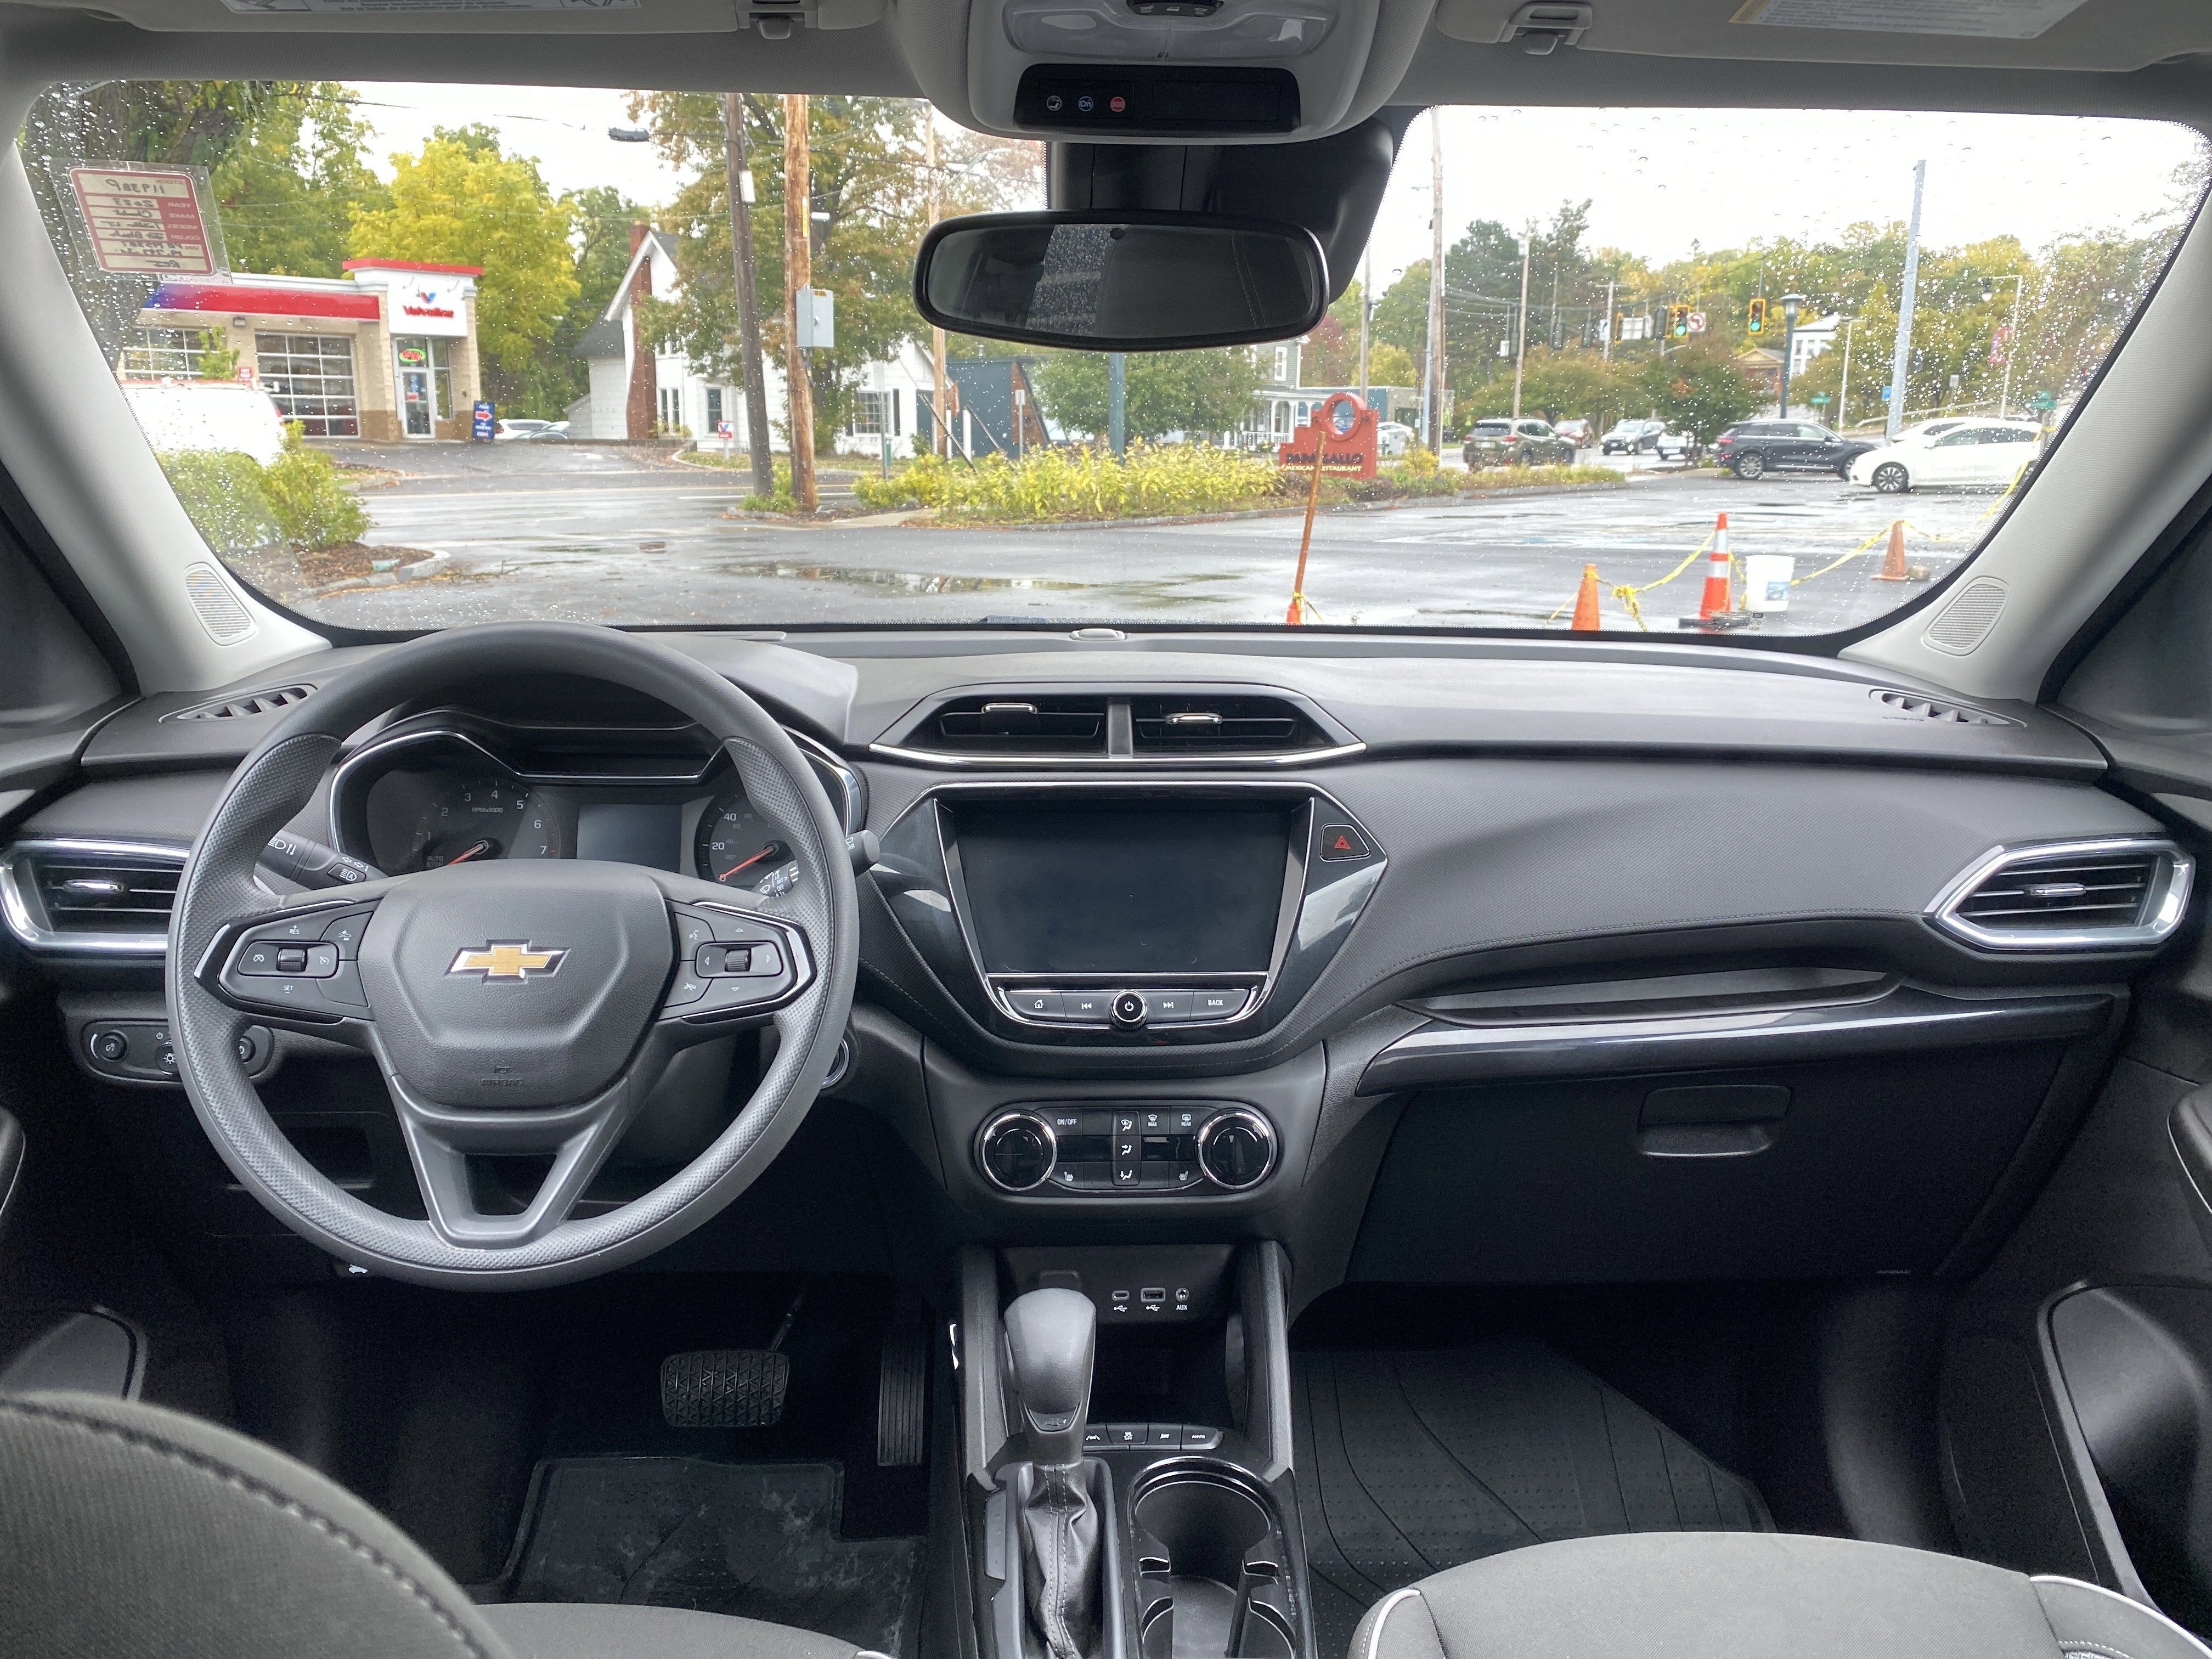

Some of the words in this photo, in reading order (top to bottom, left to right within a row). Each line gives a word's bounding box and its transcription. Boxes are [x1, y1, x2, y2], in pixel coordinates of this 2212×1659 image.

[465, 793, 472, 802] 3
[491, 790, 498, 799] 4
[516, 800, 523, 809] 5
[441, 807, 448, 816] 2
[724, 813, 736, 821] 40
[534, 820, 541, 829] 6
[540, 845, 547, 855] 7
[712, 842, 725, 850] 20
[776, 883, 785, 891] OFF
